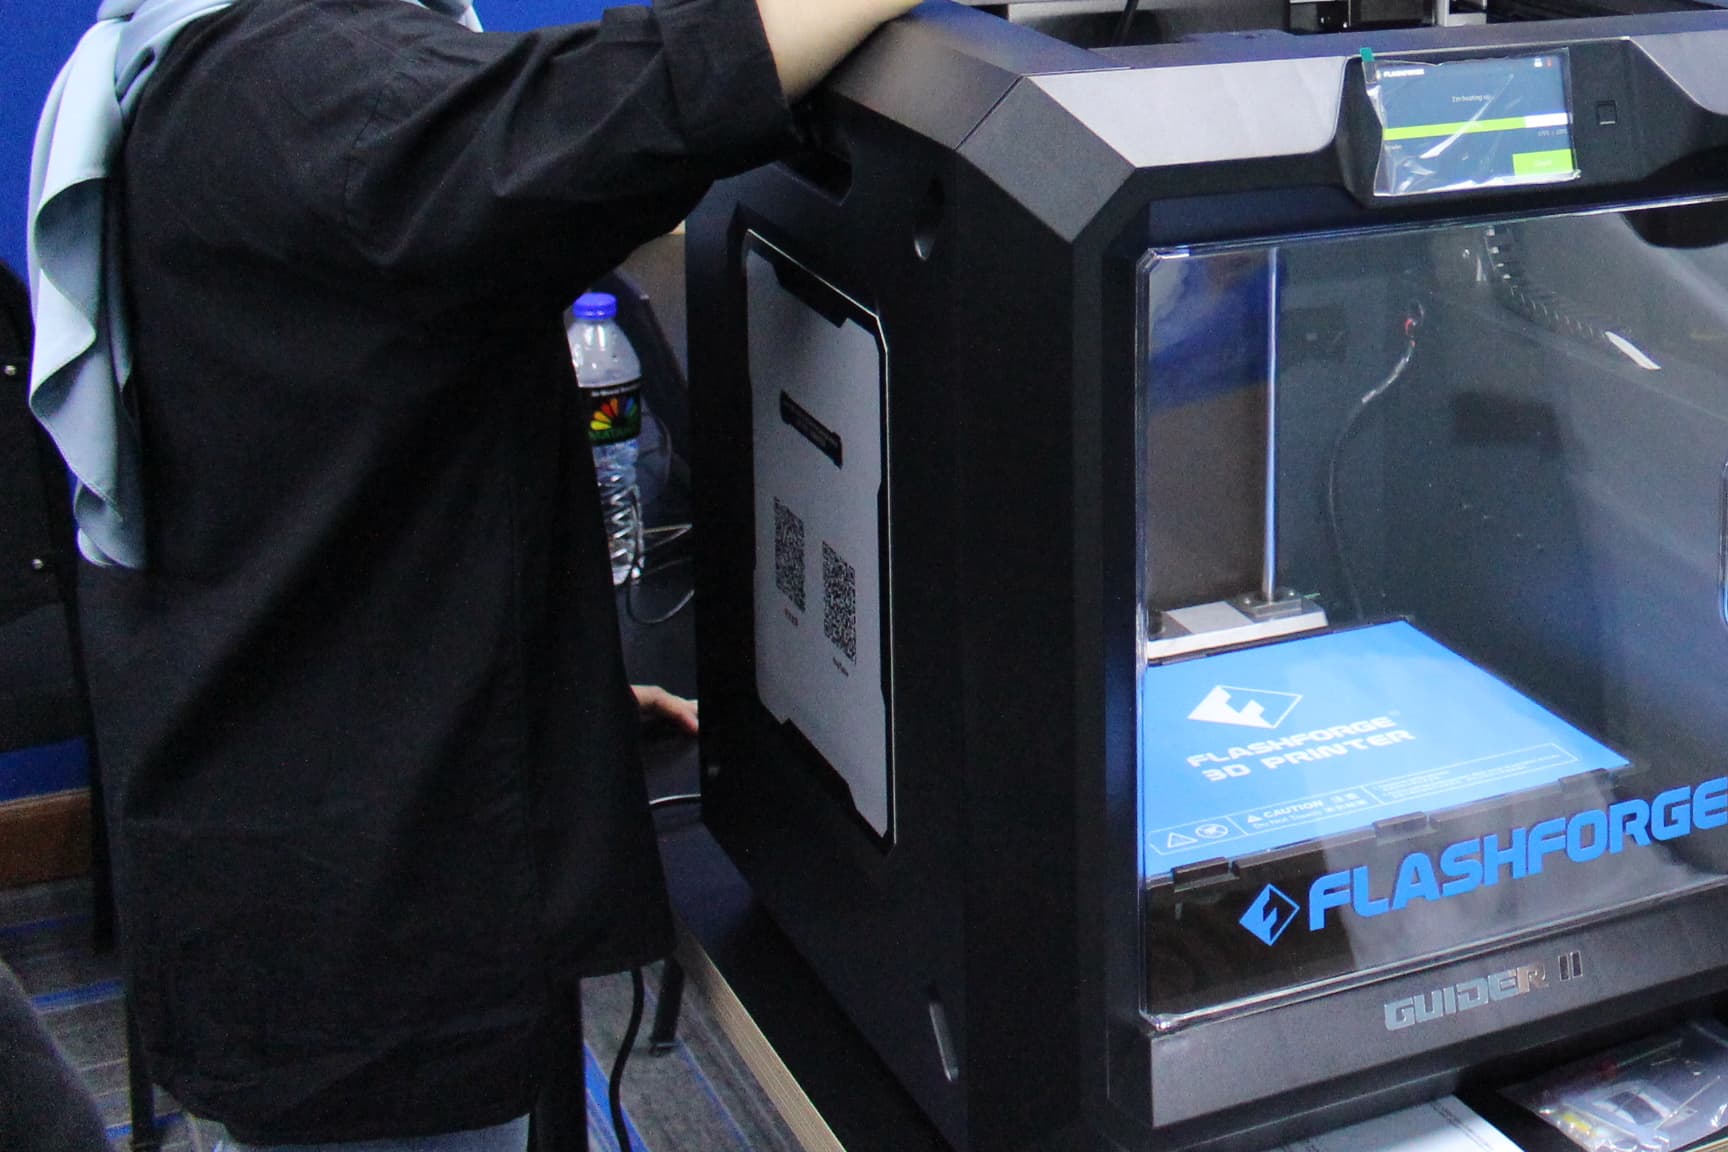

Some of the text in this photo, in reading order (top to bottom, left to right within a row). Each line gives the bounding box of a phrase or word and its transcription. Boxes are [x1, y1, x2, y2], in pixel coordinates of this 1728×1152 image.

[1186, 716, 1397, 768] FLASHFORGE
[1202, 729, 1417, 782] 3D PRINTER
[1263, 799, 1324, 819] CAUTION
[1383, 961, 1550, 1032] GUIDER
